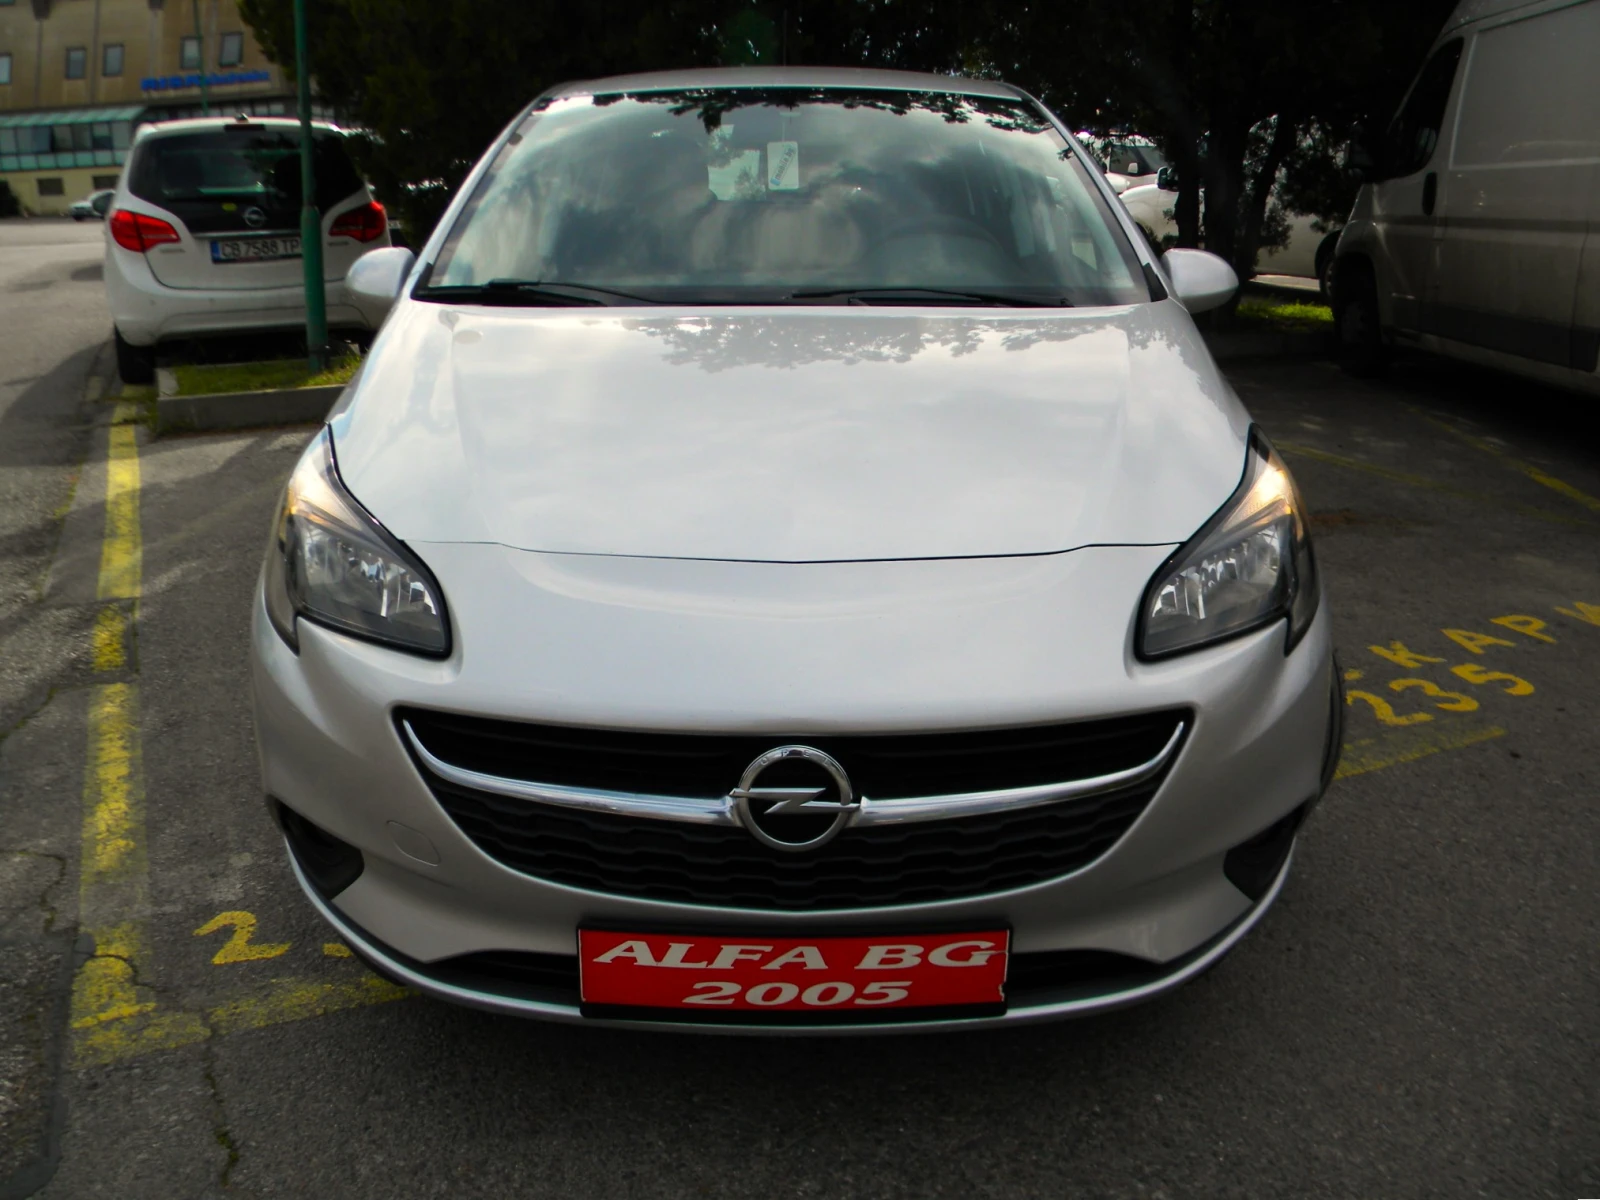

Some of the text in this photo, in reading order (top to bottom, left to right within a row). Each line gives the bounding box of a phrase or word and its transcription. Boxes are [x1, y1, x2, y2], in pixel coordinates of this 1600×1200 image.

[593, 940, 996, 970] ALFA BG
[682, 981, 913, 1006] 2005
